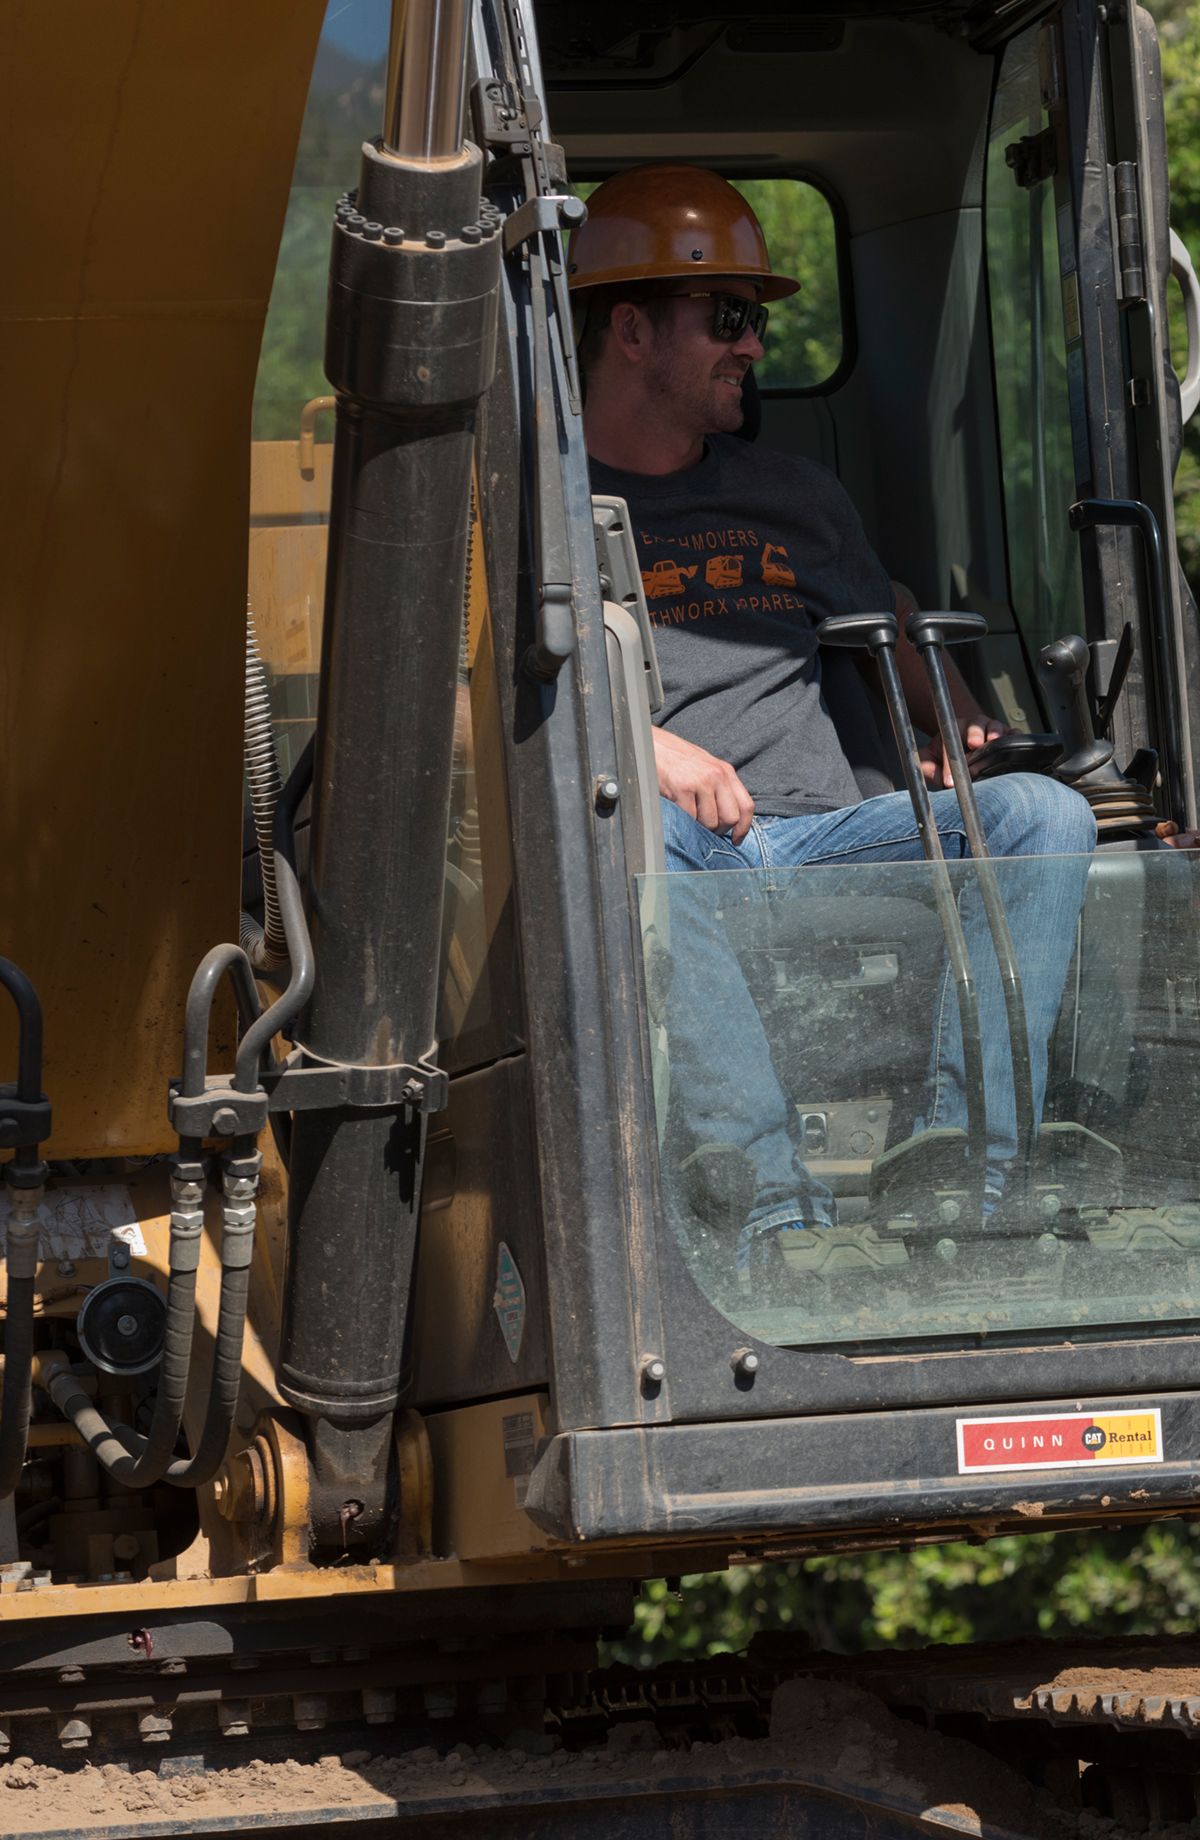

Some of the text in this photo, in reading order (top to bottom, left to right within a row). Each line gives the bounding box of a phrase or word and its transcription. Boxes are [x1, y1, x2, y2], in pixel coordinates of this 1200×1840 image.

[640, 529, 759, 550] EMOVERS
[983, 1431, 1152, 1451] QUINN CAT Rental
